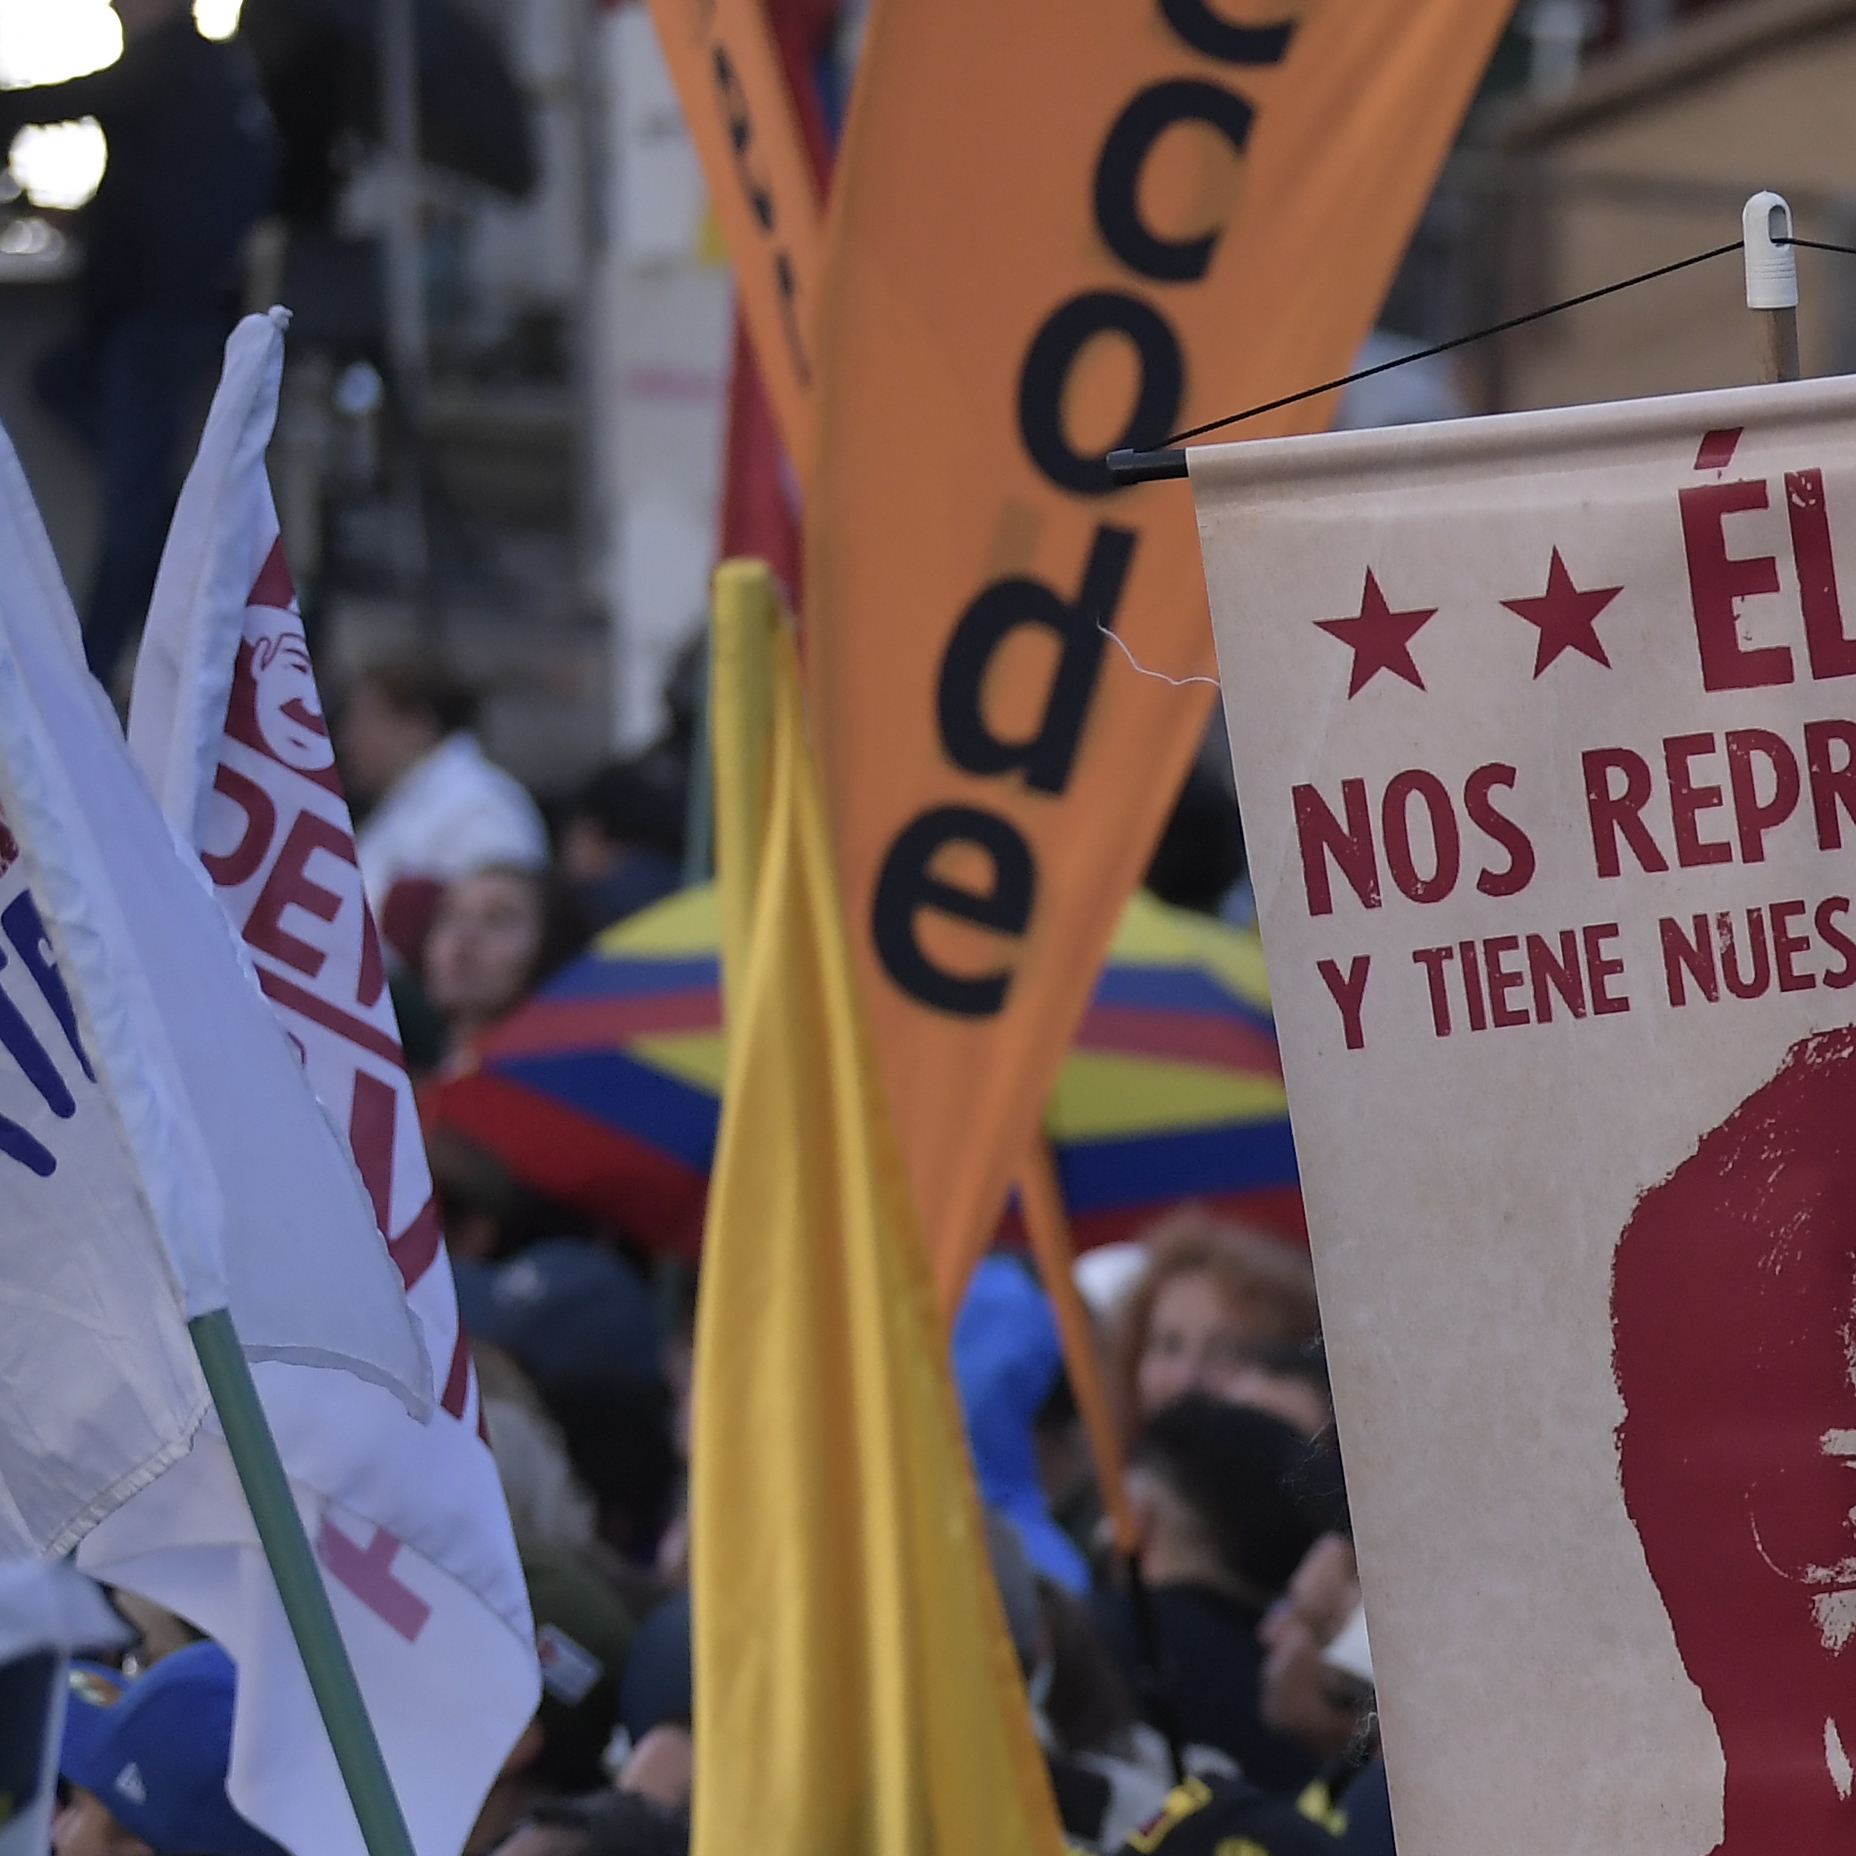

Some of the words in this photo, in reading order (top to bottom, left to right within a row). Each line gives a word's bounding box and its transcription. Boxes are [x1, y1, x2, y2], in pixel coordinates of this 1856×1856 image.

[1291, 760, 1536, 917] NOS
[1316, 953, 1372, 1051] Y
[1413, 921, 1631, 1037] TIENE
